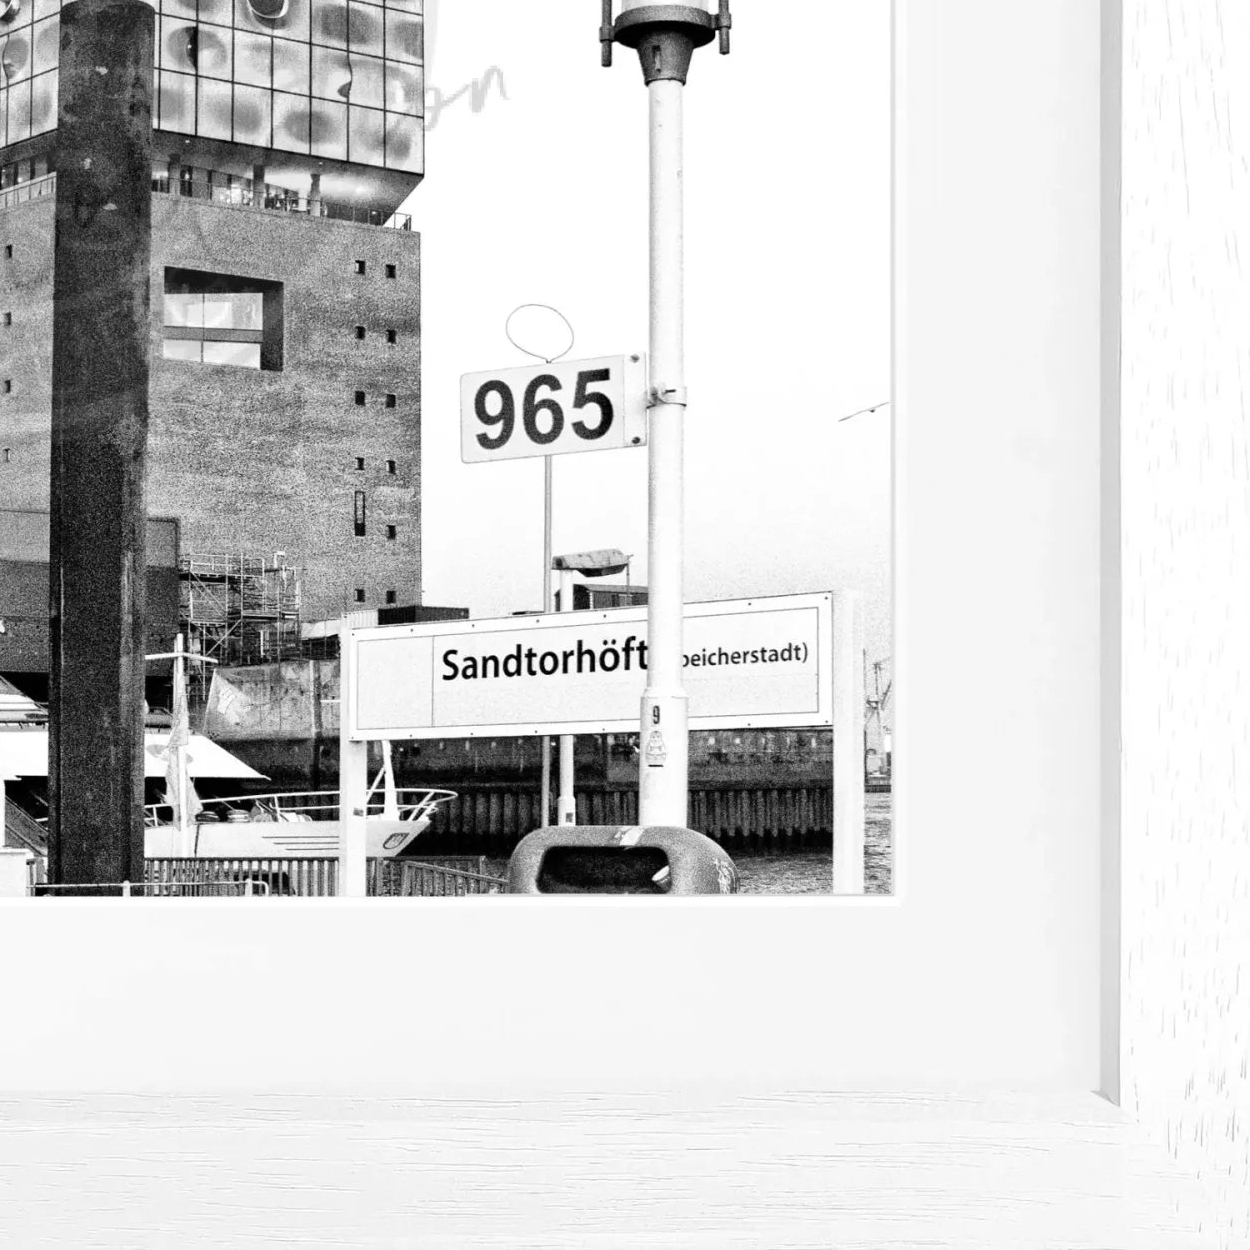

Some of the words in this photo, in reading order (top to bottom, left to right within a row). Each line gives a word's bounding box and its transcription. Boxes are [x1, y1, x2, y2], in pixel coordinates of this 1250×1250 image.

[475, 368, 613, 450] 965
[442, 635, 649, 681] Sandtorhöft
[652, 705, 661, 725] 9
